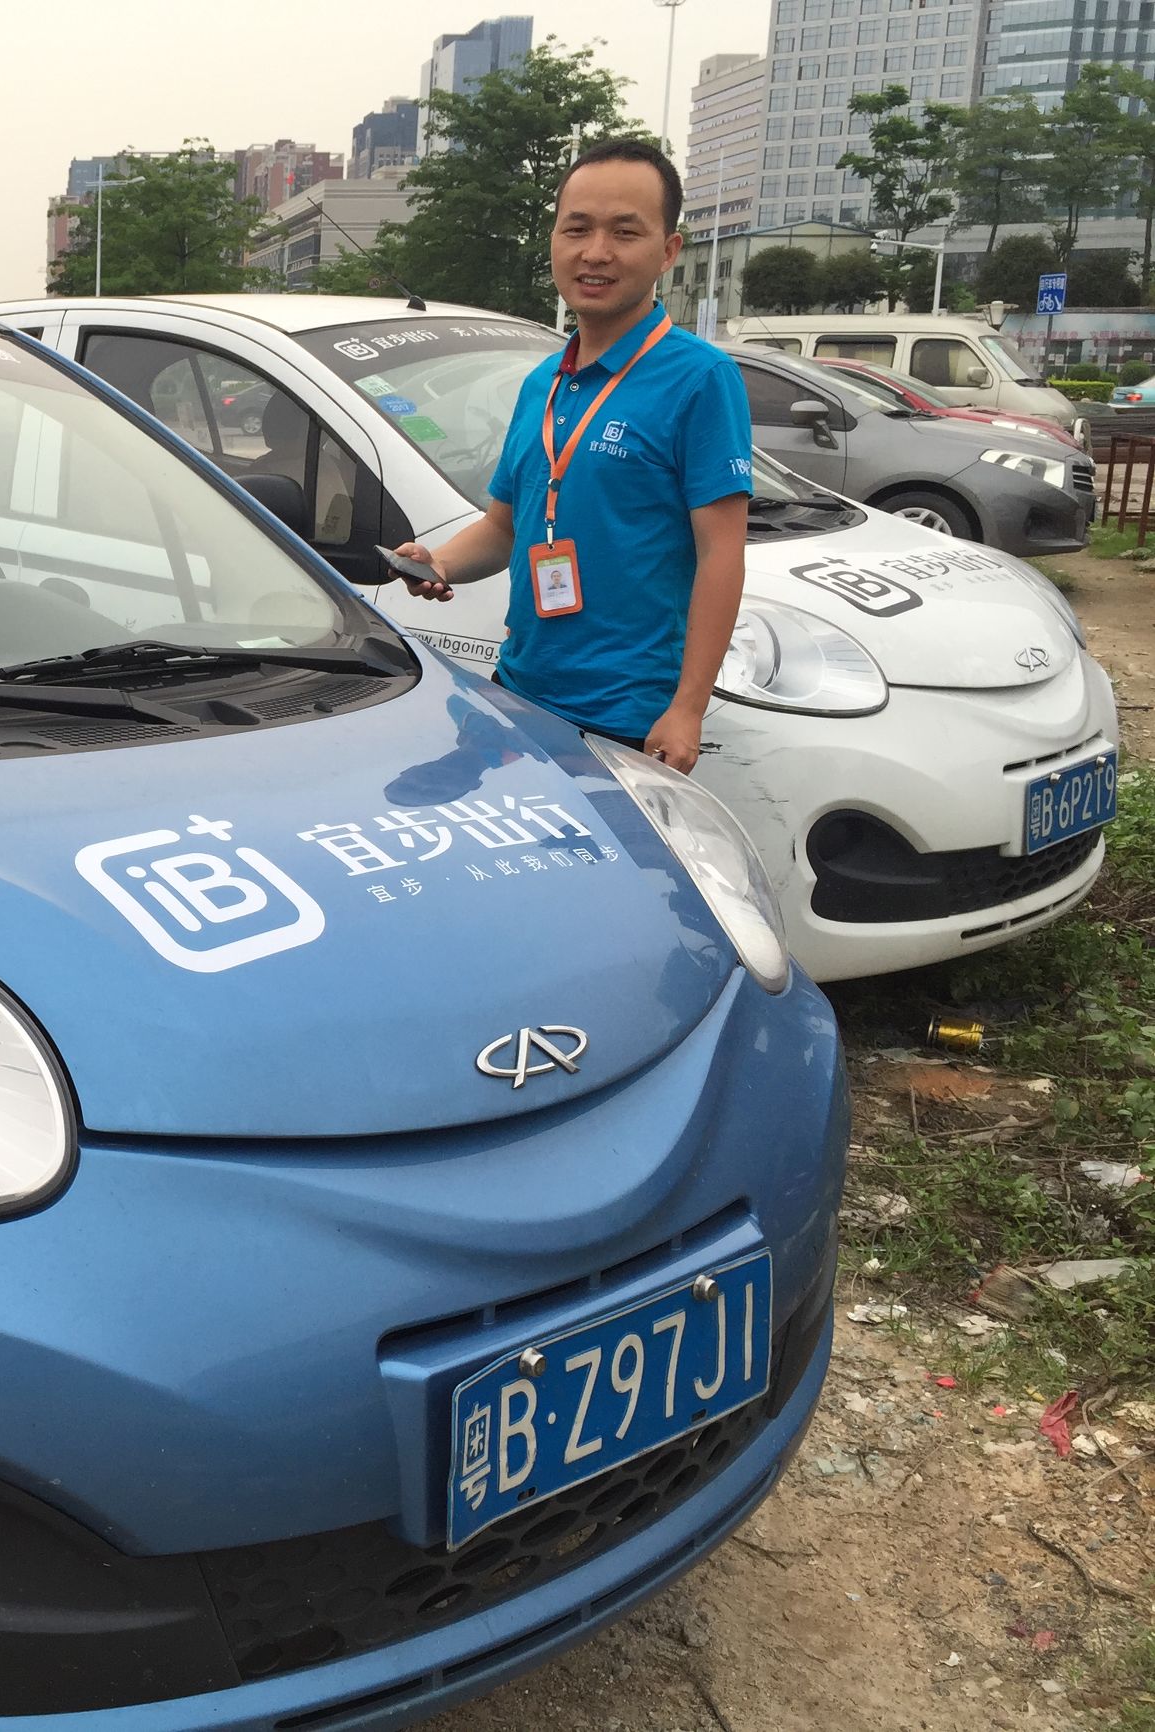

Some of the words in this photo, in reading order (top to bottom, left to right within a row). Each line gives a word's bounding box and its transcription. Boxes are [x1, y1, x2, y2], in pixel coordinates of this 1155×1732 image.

[589, 440, 628, 459] 宜步出行
[297, 794, 592, 877] 宜步出行
